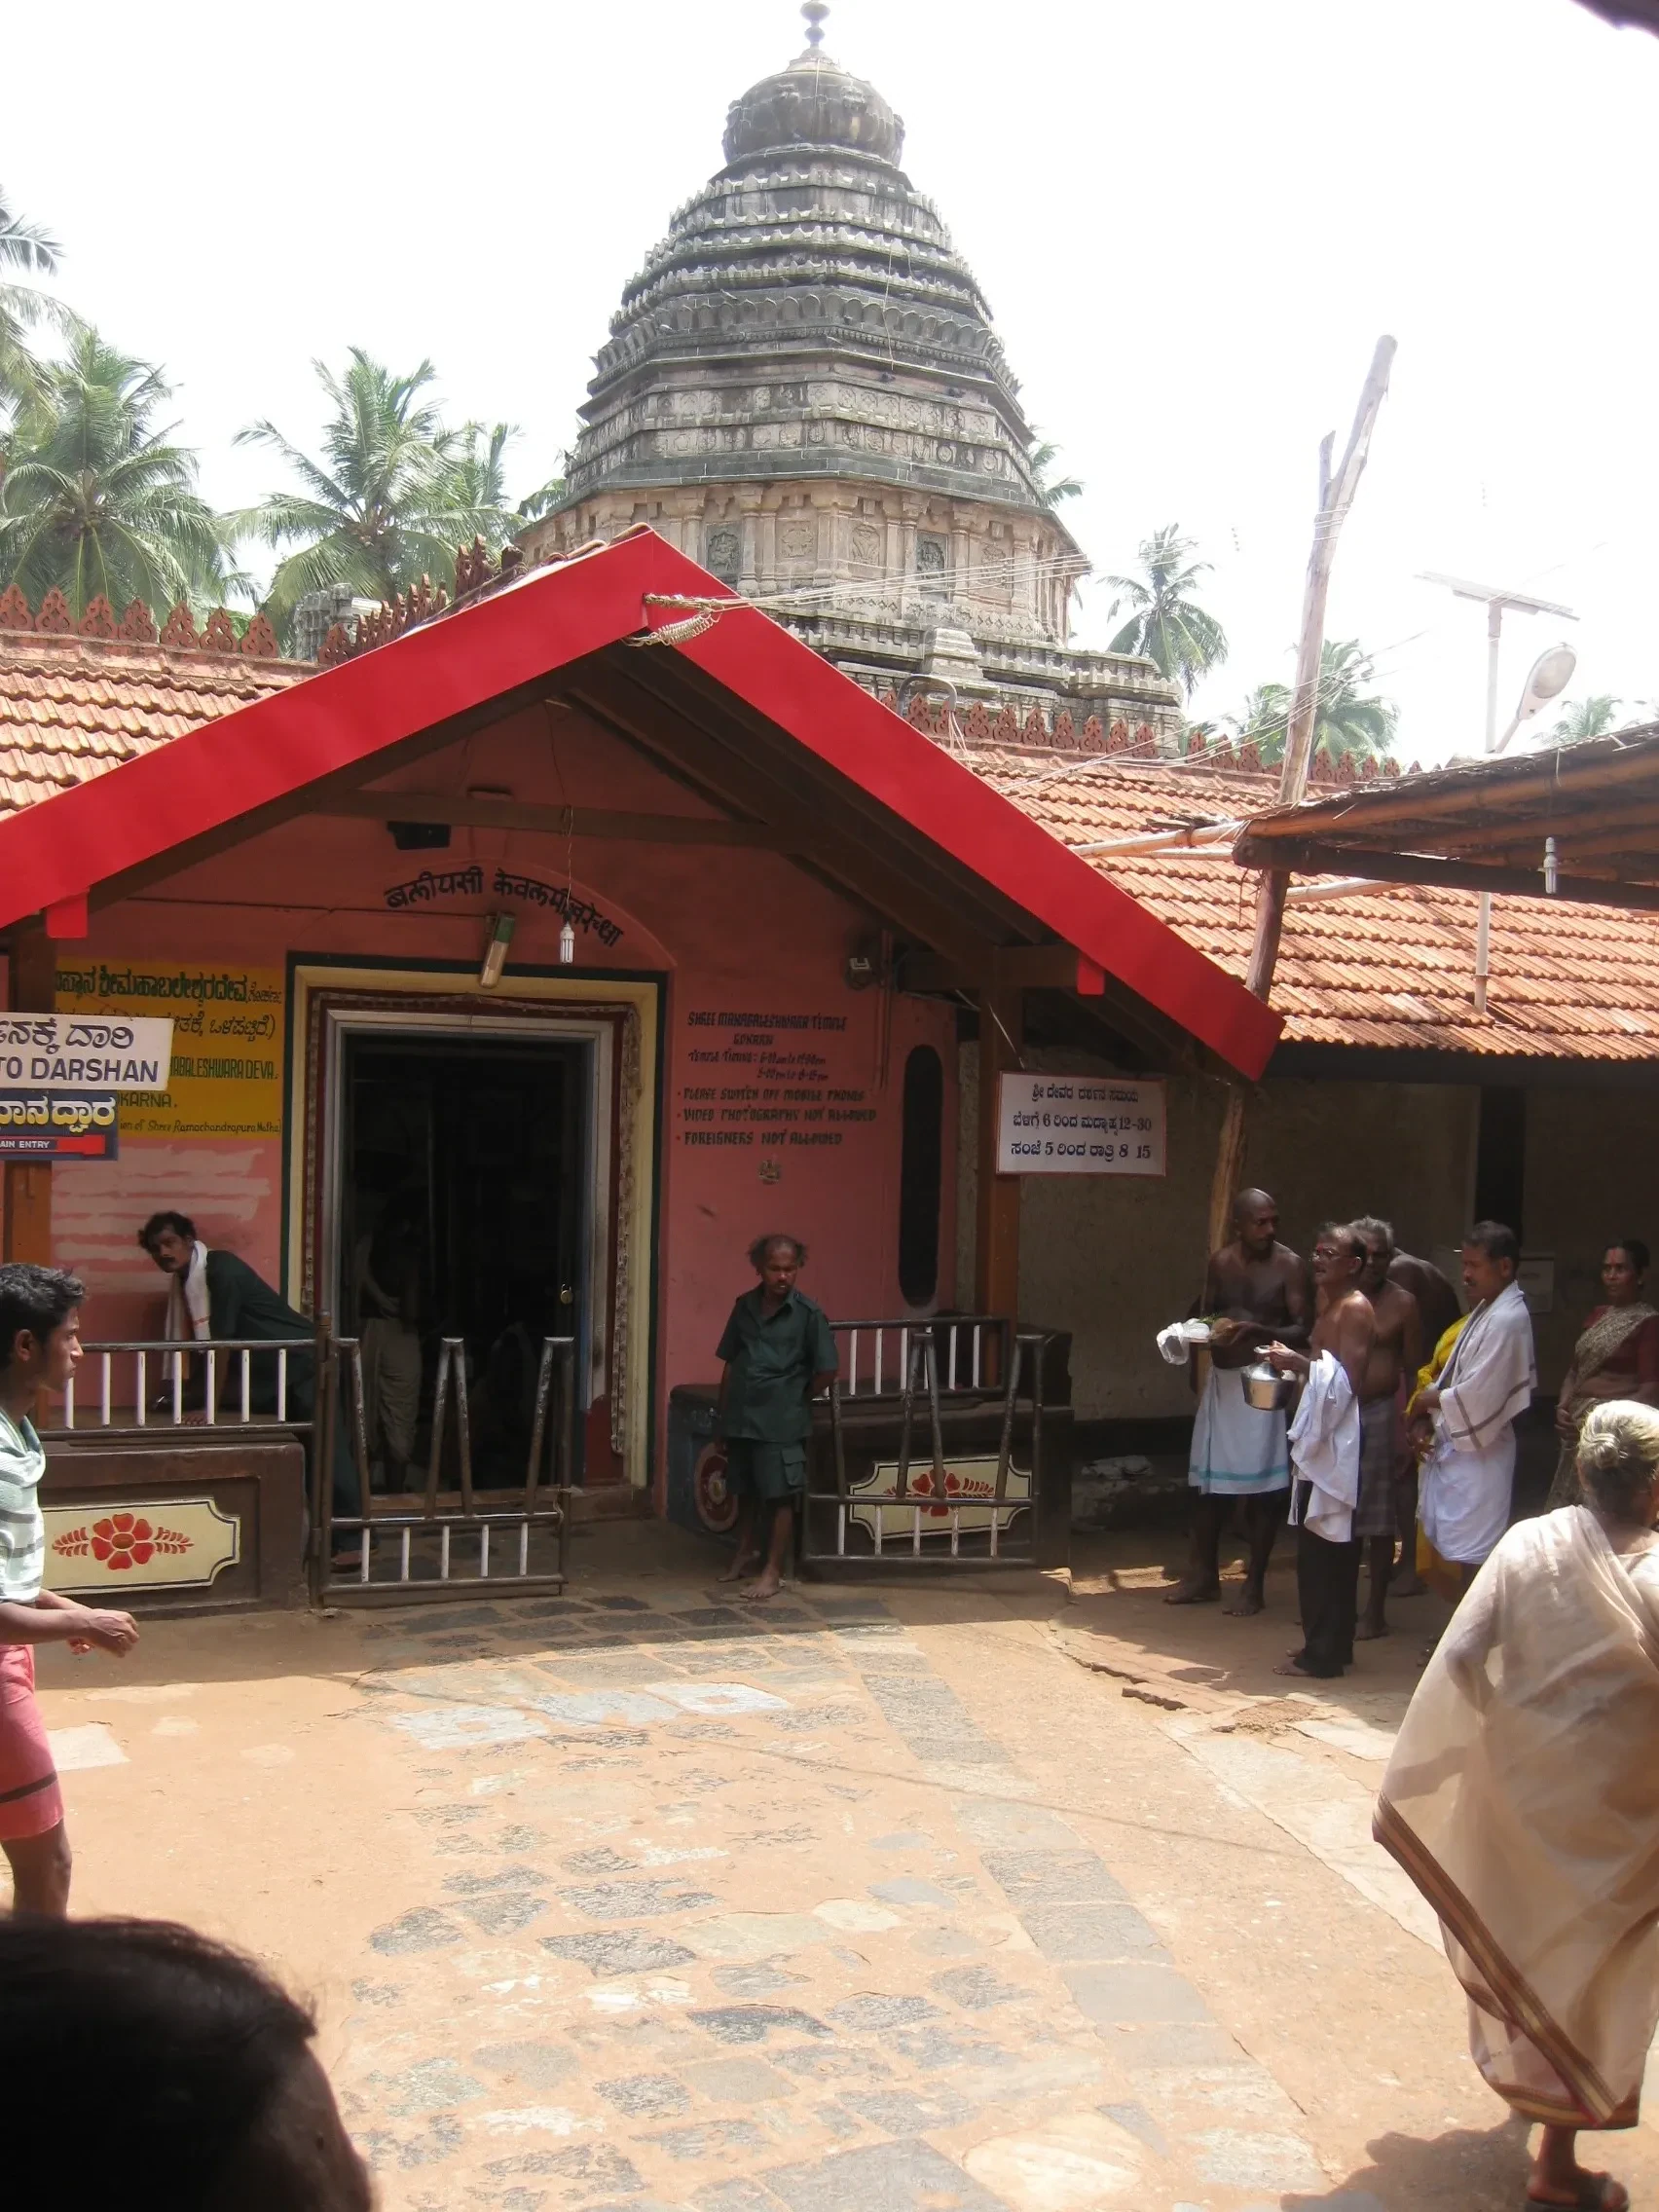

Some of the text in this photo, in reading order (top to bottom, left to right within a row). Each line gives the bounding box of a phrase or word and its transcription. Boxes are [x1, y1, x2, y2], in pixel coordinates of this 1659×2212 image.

[687, 1011, 716, 1027] SHREE
[66, 1023, 134, 1049] ದಾರಿ
[31, 1057, 159, 1083] DARSHAN
[683, 1108, 714, 1122] VIDEO
[1043, 1113, 1051, 1127] 6
[1053, 1114, 1078, 1127] ರಿಂದ
[1119, 1116, 1152, 1131] 12-30
[18, 1140, 50, 1149] ENTRY
[683, 1128, 843, 1146] FOREIGNERS NOT ALLOWED
[1011, 1140, 1041, 1156] ಸಂಜೆ
[1045, 1141, 1053, 1156] 5
[1056, 1141, 1086, 1156] ರಿಂದ
[1119, 1143, 1128, 1158] 8
[1136, 1145, 1151, 1159] 15
